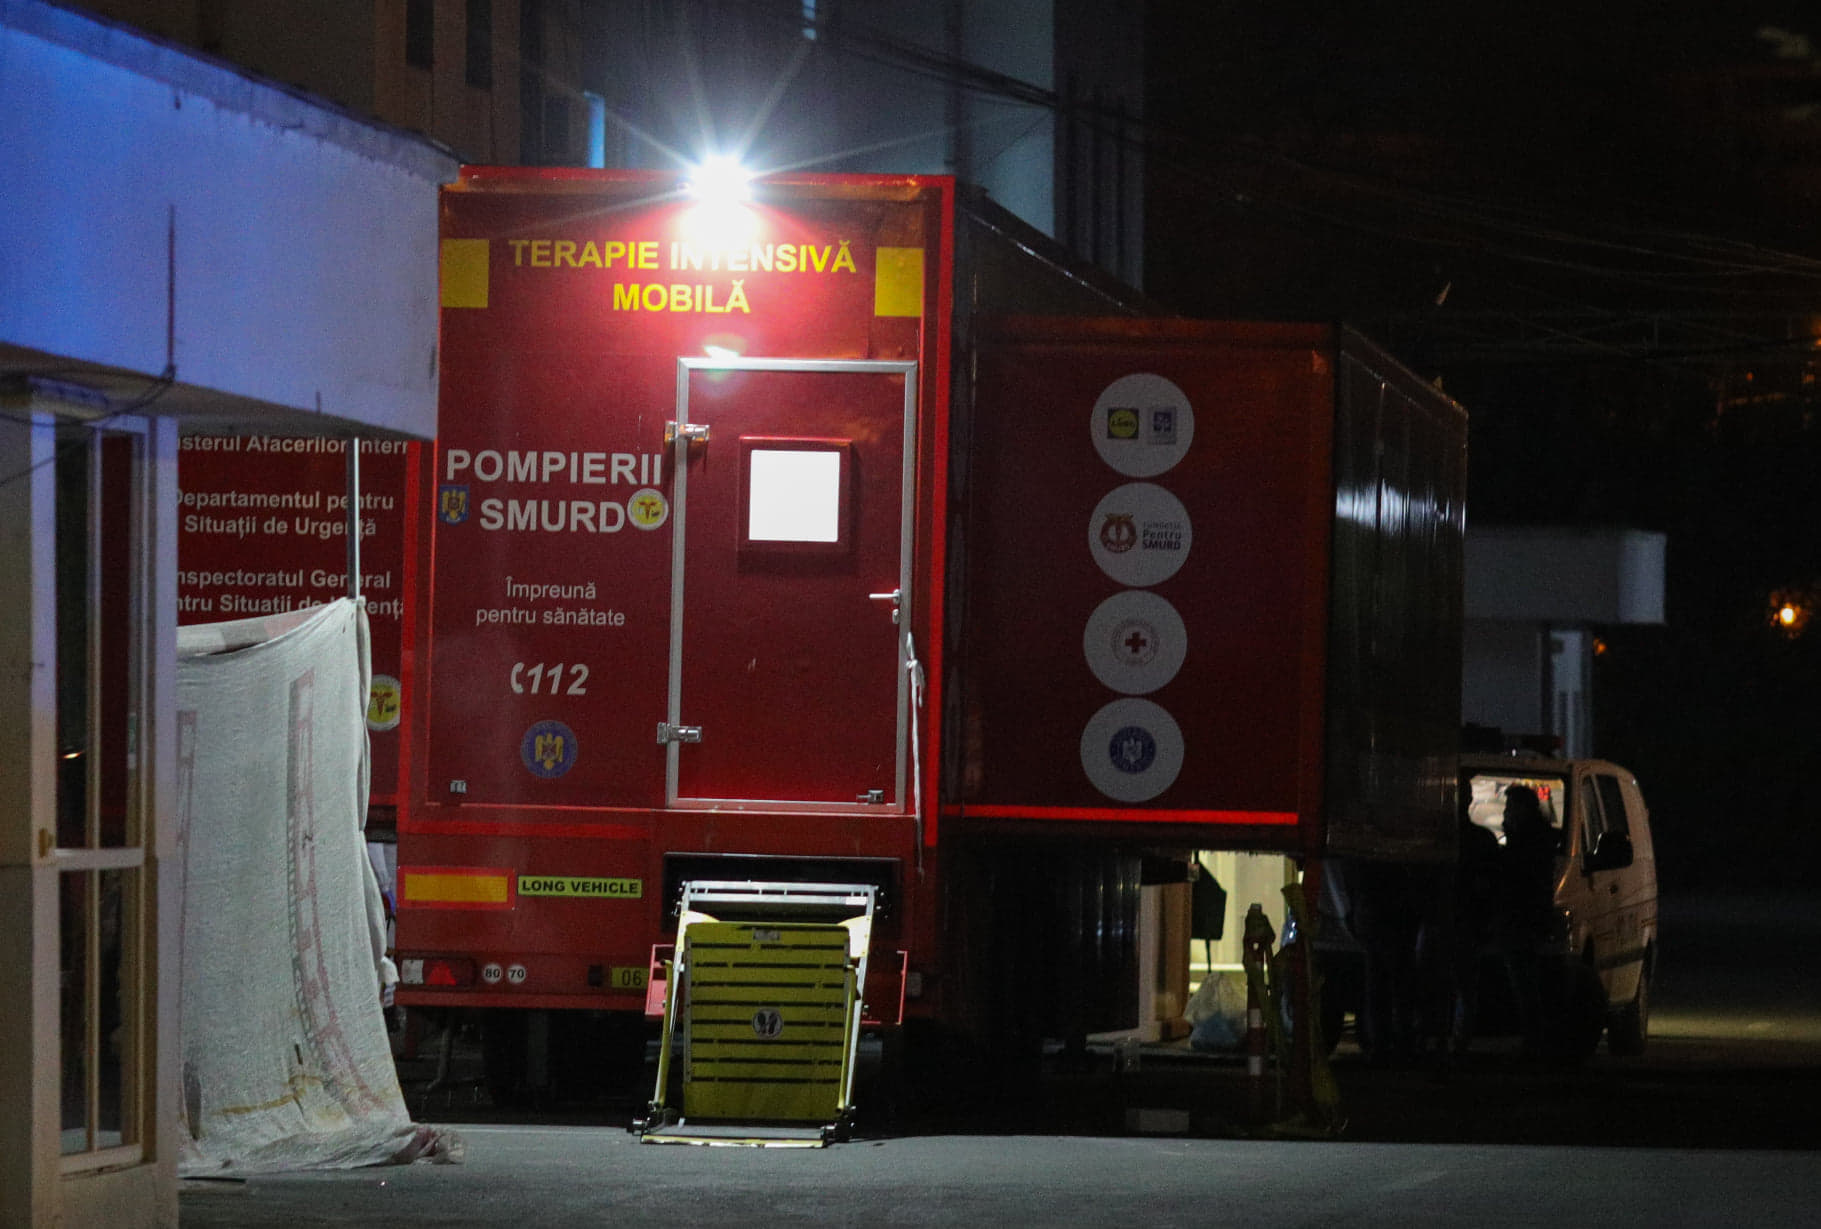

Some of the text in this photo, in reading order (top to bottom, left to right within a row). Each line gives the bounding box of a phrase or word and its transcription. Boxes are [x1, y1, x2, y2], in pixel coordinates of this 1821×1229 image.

[507, 240, 660, 270] TERAPIE
[612, 281, 751, 314] MOBILĂ
[446, 448, 662, 486] POMPIERII
[263, 516, 288, 534] de
[479, 498, 626, 534] SMURD
[505, 575, 597, 602] Împreună
[475, 607, 626, 627] pentru sănătate
[526, 662, 591, 696] 112
[521, 881, 640, 895] LONG VEHICLE
[485, 969, 501, 979] 80
[509, 968, 526, 980] 70
[621, 969, 643, 987] 06
